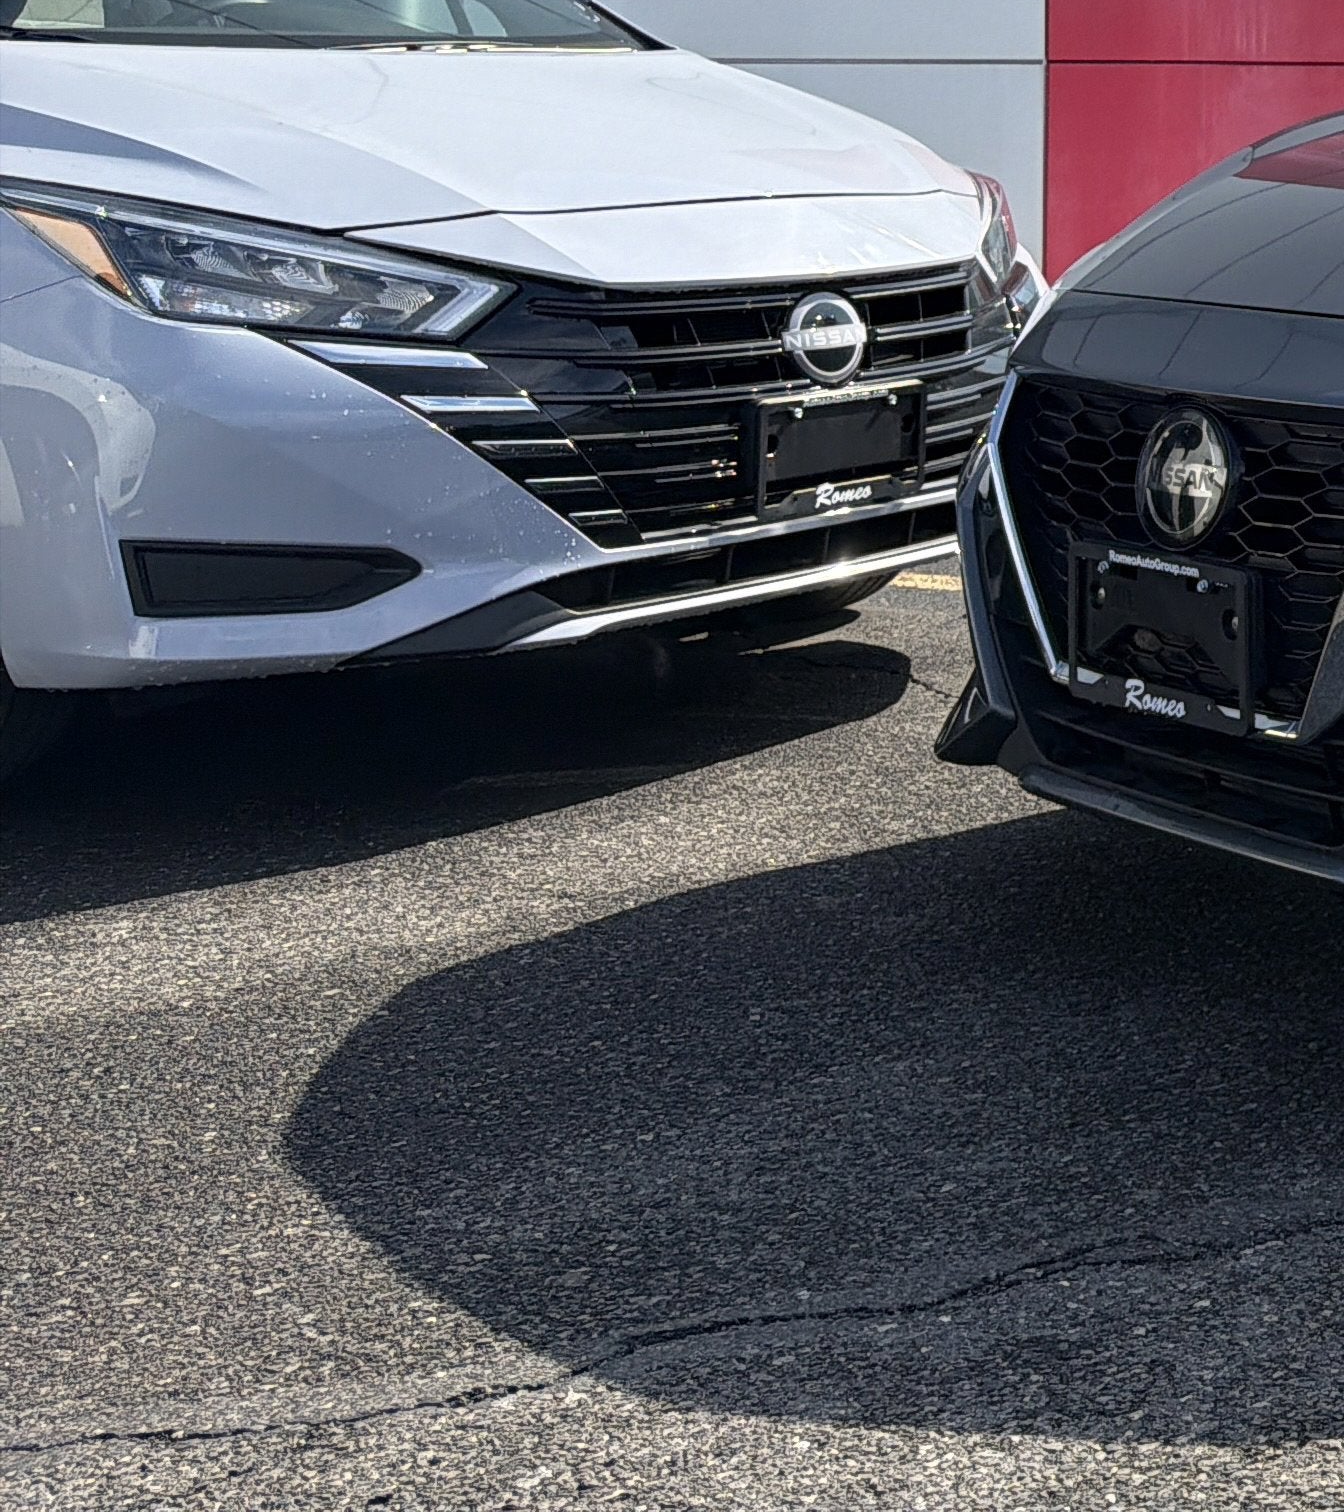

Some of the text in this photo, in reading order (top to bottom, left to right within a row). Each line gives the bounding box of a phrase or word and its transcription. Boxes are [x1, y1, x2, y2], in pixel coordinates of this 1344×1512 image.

[785, 325, 867, 349] NISSAN
[815, 481, 873, 509] Romeo
[1108, 548, 1200, 578] RomeoAutoGroup.com
[1124, 678, 1187, 719] Romeo
